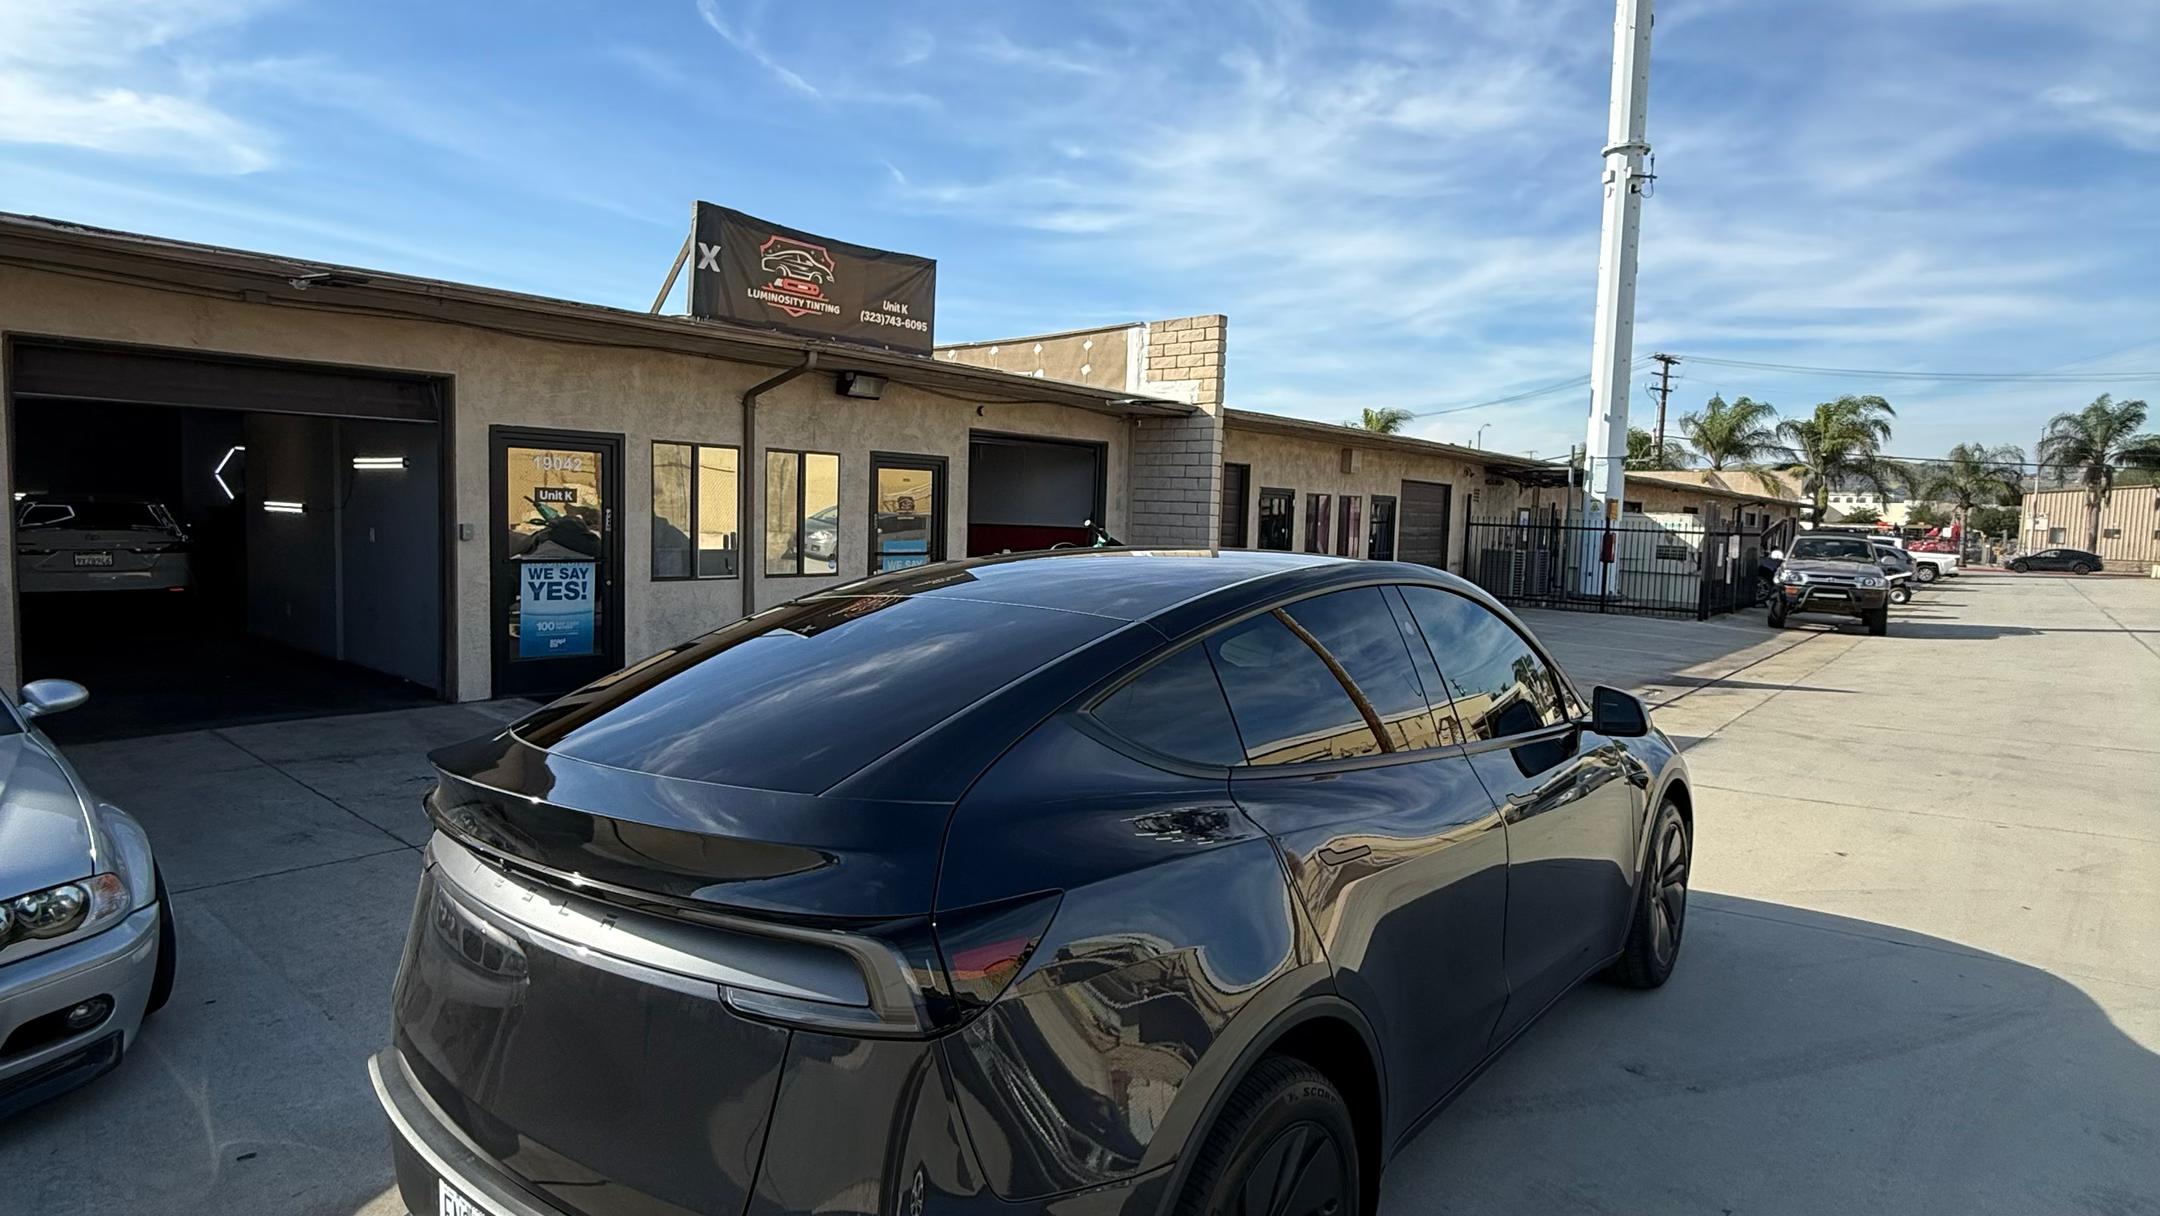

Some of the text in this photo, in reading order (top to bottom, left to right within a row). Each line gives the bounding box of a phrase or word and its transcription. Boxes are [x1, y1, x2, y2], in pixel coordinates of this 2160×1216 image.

[747, 288, 841, 315] LUMINOSITY TINTING
[882, 300, 909, 315] Unit K
[860, 310, 928, 332] (323)743-6095
[532, 455, 583, 472] 19042
[539, 490, 574, 501] Unit K
[528, 567, 589, 580] WE SAY
[528, 581, 588, 601] YES!
[536, 621, 555, 632] 100
